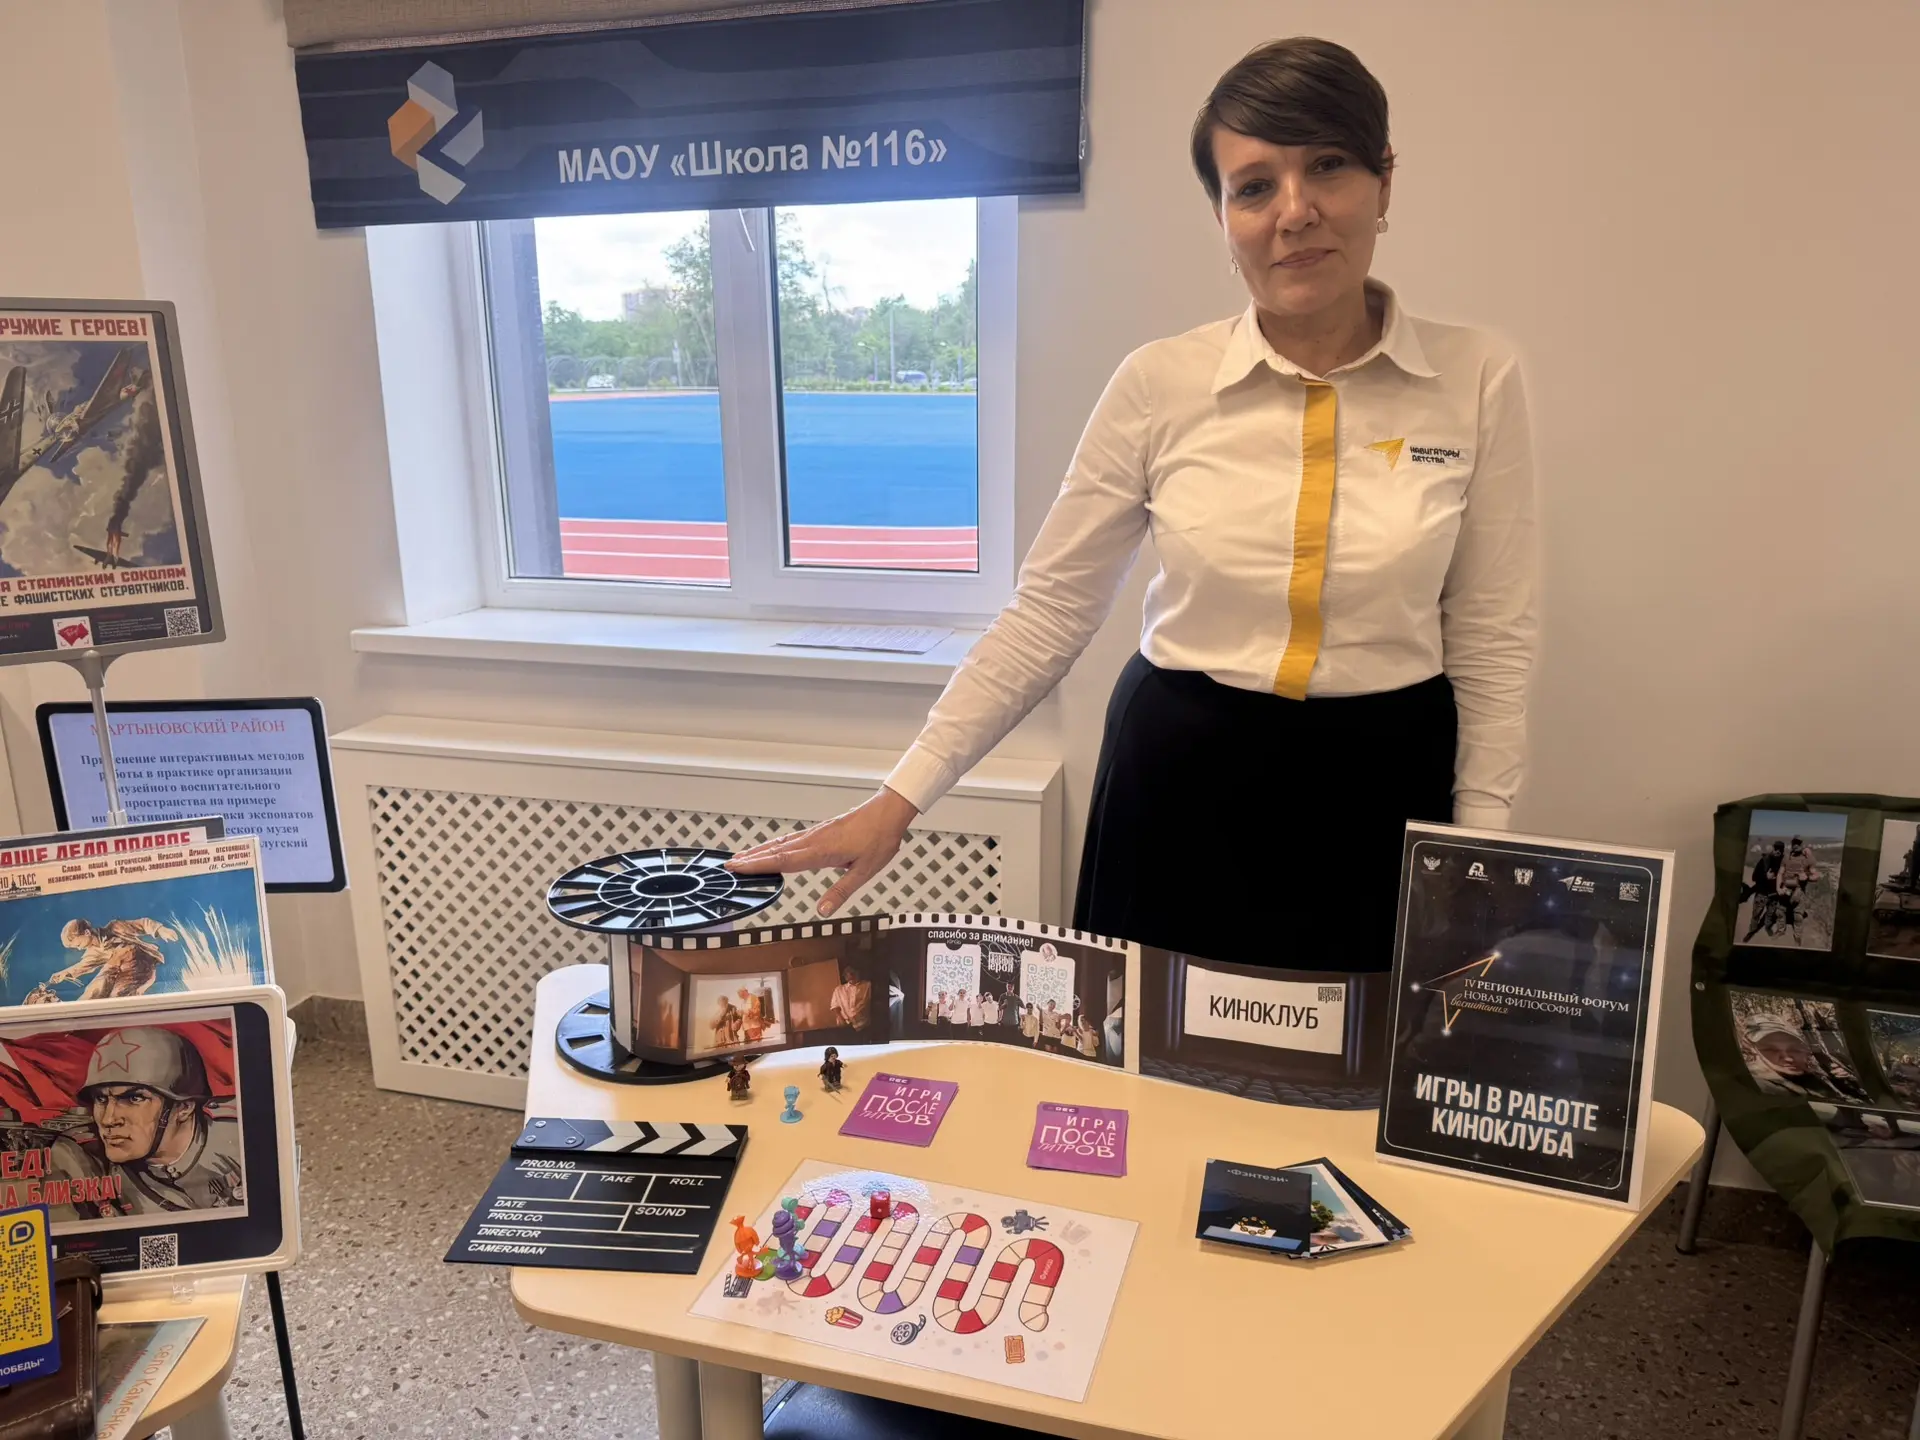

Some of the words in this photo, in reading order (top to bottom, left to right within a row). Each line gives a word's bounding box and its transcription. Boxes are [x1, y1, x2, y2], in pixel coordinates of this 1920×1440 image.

[558, 143, 659, 184] МАОУ
[670, 138, 809, 178] «Школа
[822, 129, 948, 170] №116»
[71, 318, 147, 336] ГЕРОЕВ!
[17, 573, 115, 591] СТАЛИНСКИМ
[121, 567, 186, 583] СОКОЛАМ
[14, 587, 94, 605] ФАШИСТСКИХ
[100, 580, 189, 598] СТЕРВЯТНИКОВ.
[231, 719, 285, 734] РАЙОН
[160, 751, 254, 766] интерактивных
[258, 751, 305, 763] методов
[146, 770, 154, 779] в
[157, 769, 214, 781] практике
[217, 766, 292, 779] организации
[180, 781, 281, 793] воспитательного
[125, 796, 206, 810] пространства
[209, 797, 224, 807] на
[227, 796, 276, 809] примере
[248, 810, 314, 820] экспонатов
[267, 825, 299, 836] музея
[928, 928, 967, 940] спасибо
[969, 932, 980, 941] за
[982, 932, 1034, 948] внимание!
[1464, 978, 1477, 988] IV
[1477, 981, 1579, 1005] РЕГИОНАЛЬНЫЙ
[1581, 997, 1630, 1013] ФОРУМ
[1463, 990, 1503, 1004] НОВАЯ
[1505, 996, 1582, 1017] ФИЛОСОФИЯ
[1209, 994, 1319, 1030] КИНОКЛУБ
[894, 1086, 942, 1101] ИГРА
[863, 1094, 939, 1115] ПОСЛЕ
[1416, 1072, 1481, 1111] ИГРЫ
[1487, 1086, 1502, 1115] В
[1507, 1090, 1599, 1132] РАБОТЕ
[1066, 1115, 1116, 1131] ИГРА
[1040, 1125, 1117, 1146] ПОСЛЕ
[1431, 1106, 1574, 1159] КИНОКЛУБА
[520, 1159, 576, 1170] PROD.NO.
[524, 1171, 572, 1181] SCENE
[599, 1175, 635, 1184] TAKE
[669, 1178, 705, 1187] ROLL
[27, 1175, 122, 1205] БЛИЗКА!
[494, 1200, 527, 1209] DATE
[634, 1206, 687, 1218] SOUND
[487, 1212, 543, 1222] PROD.CO.
[477, 1227, 541, 1239] DIRECTOR
[467, 1243, 547, 1255] CAMERAMAN
